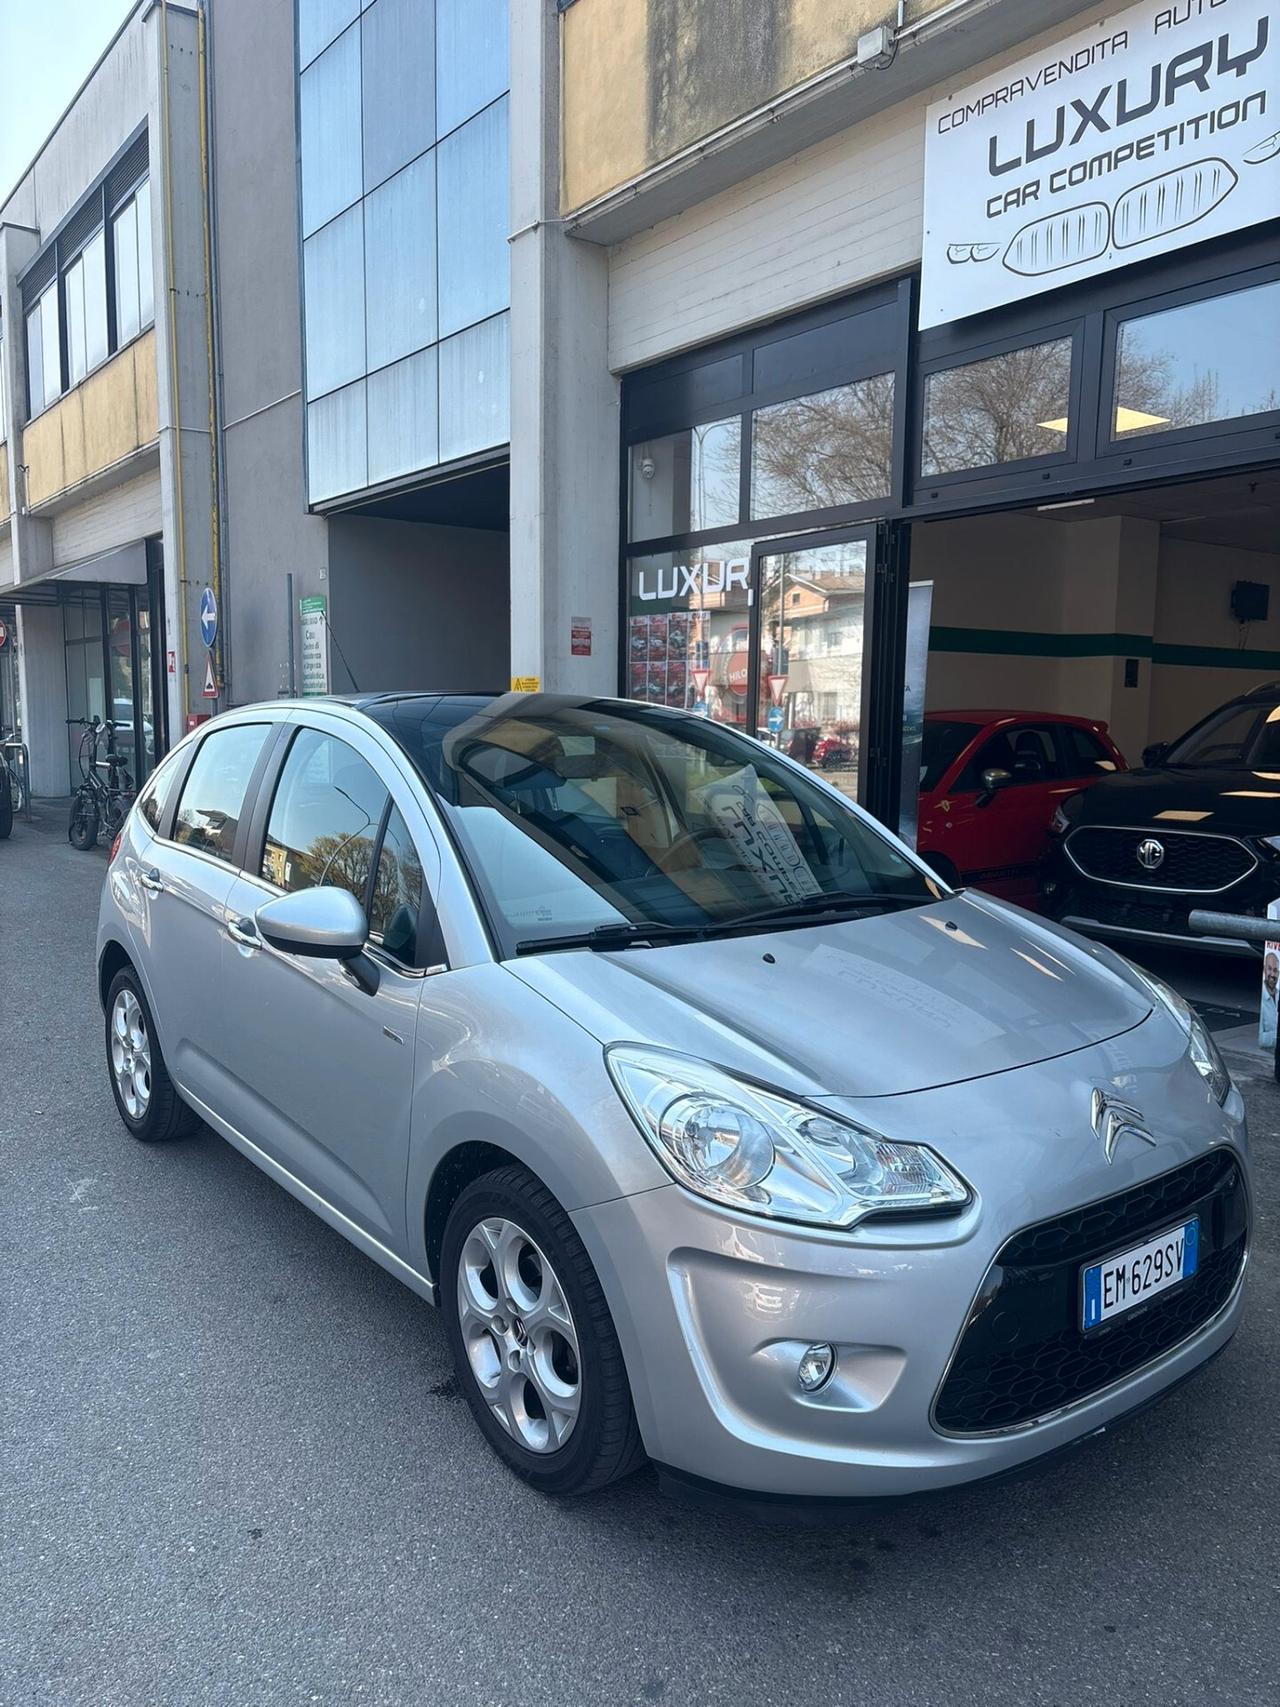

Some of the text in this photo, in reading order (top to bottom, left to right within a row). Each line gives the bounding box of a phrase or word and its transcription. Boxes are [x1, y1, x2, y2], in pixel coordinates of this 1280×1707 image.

[938, 0, 1227, 135] COMPRAVENDITA AUT
[988, 15, 1269, 177] LUXURY
[986, 90, 1266, 219] CAR COMPETITION
[639, 558, 754, 606] LUXUR
